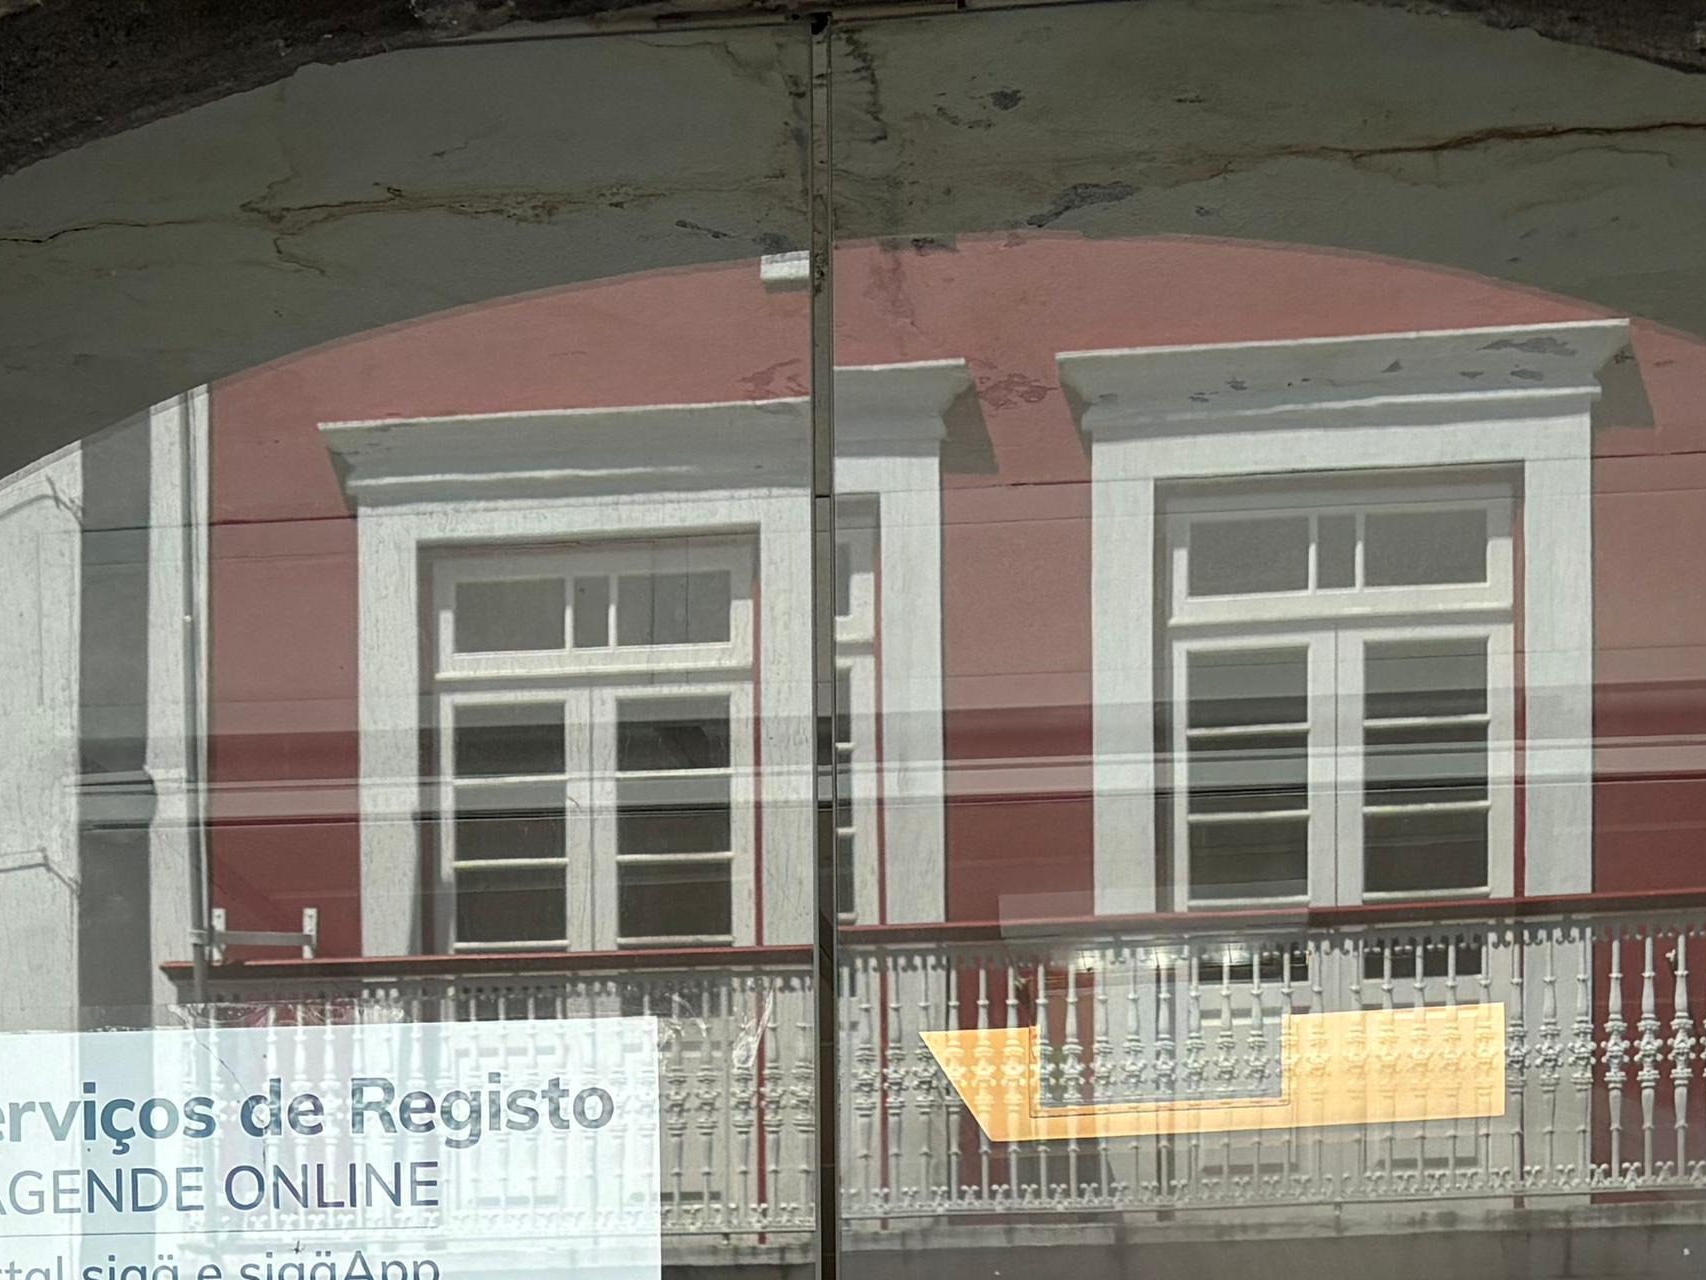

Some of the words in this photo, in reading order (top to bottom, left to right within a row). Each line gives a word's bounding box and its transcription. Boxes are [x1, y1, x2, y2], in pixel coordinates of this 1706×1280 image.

[241, 1079, 324, 1136] de
[351, 1072, 615, 1148] Registo
[224, 1161, 440, 1211] ONLINE
